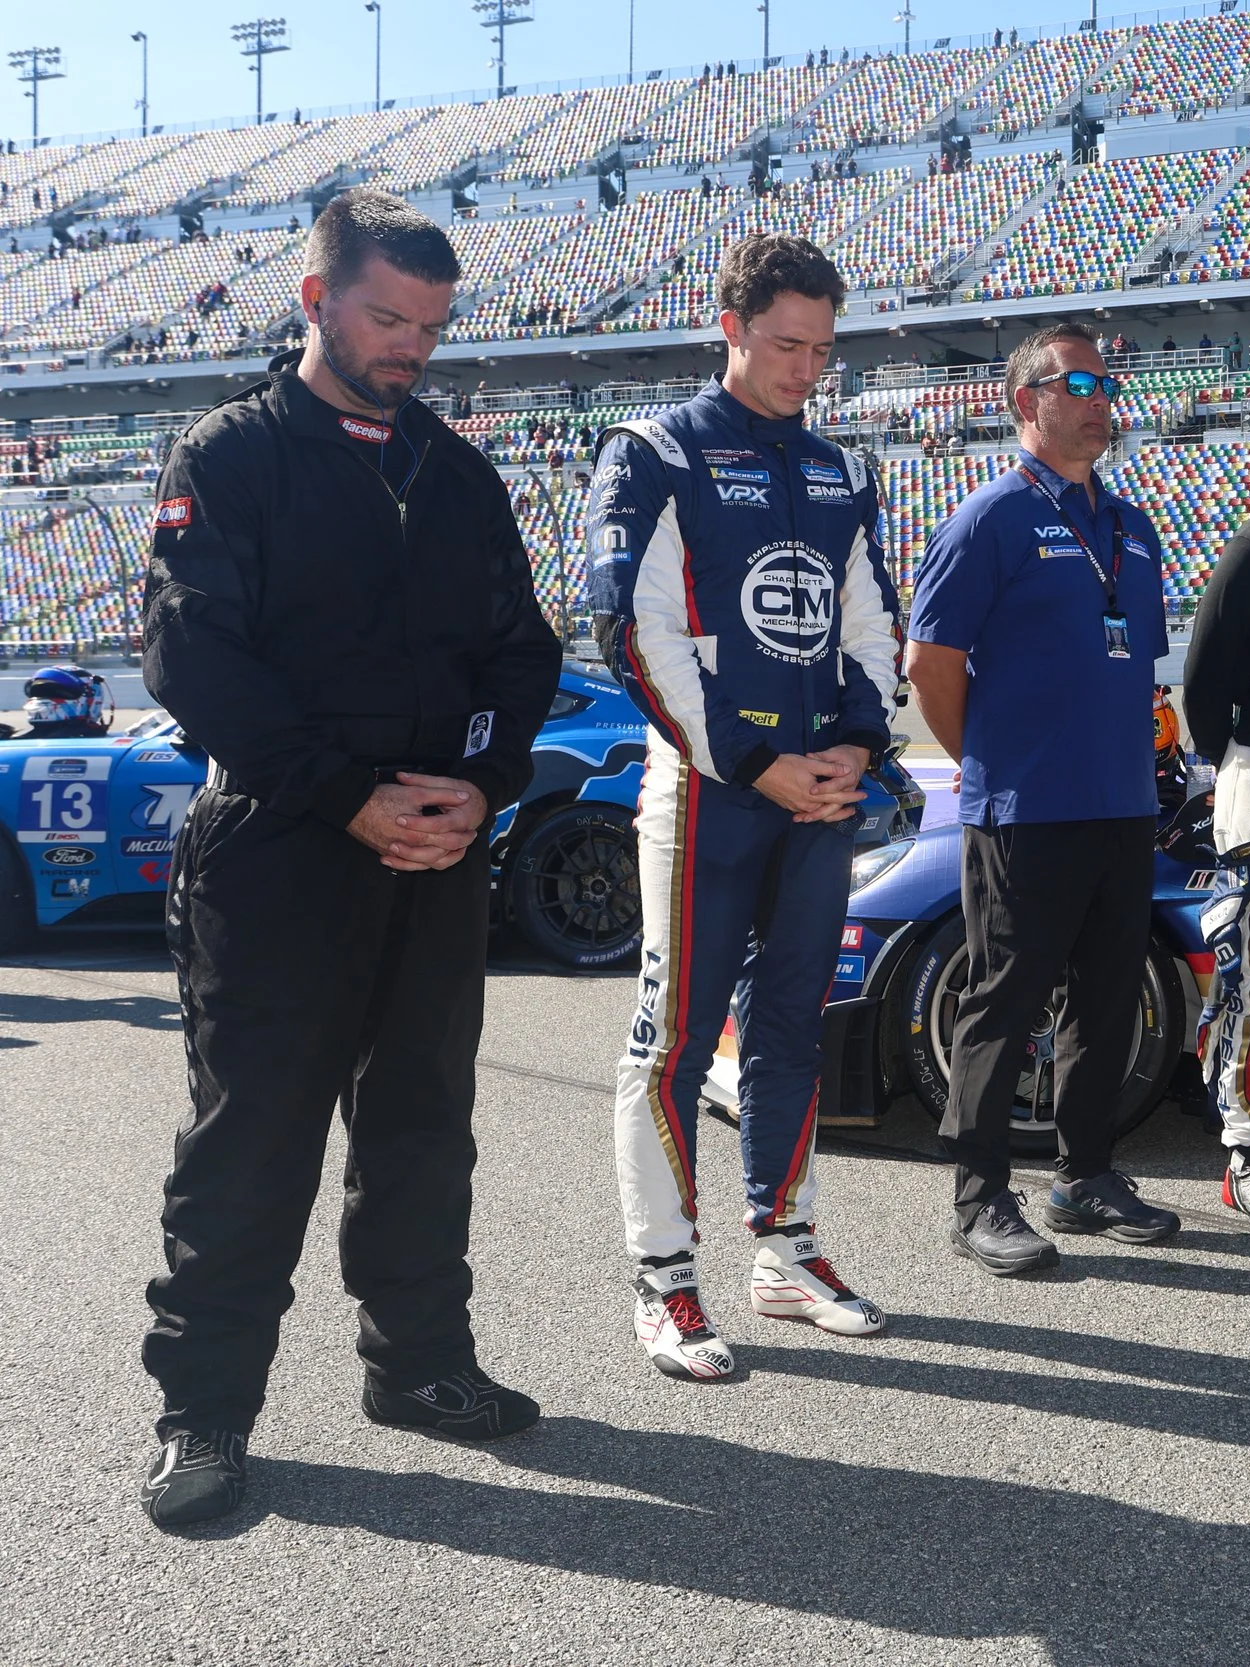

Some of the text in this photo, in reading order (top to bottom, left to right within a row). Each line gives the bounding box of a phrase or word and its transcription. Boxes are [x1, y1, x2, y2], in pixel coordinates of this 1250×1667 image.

[1180, 111, 1193, 121] 370
[976, 366, 989, 378] 164
[600, 391, 612, 402] 166
[644, 425, 679, 454] Sabelt
[728, 472, 764, 480] MICHELIN
[715, 484, 771, 504] VPX
[806, 485, 850, 497] GMP
[722, 501, 771, 510] MOTORSPORT
[1034, 526, 1073, 538] VPX
[752, 584, 832, 620] CM
[596, 722, 647, 730] PRESIDEN
[152, 753, 175, 761] GS
[31, 782, 93, 829] 13
[127, 841, 174, 852] McCUM
[52, 850, 86, 863] Ford
[579, 941, 634, 964] MICHELIN
[914, 956, 937, 1012] MICHELIN
[795, 1241, 814, 1252] OMP
[670, 1271, 694, 1282] OMP
[694, 1349, 730, 1370] OMP
